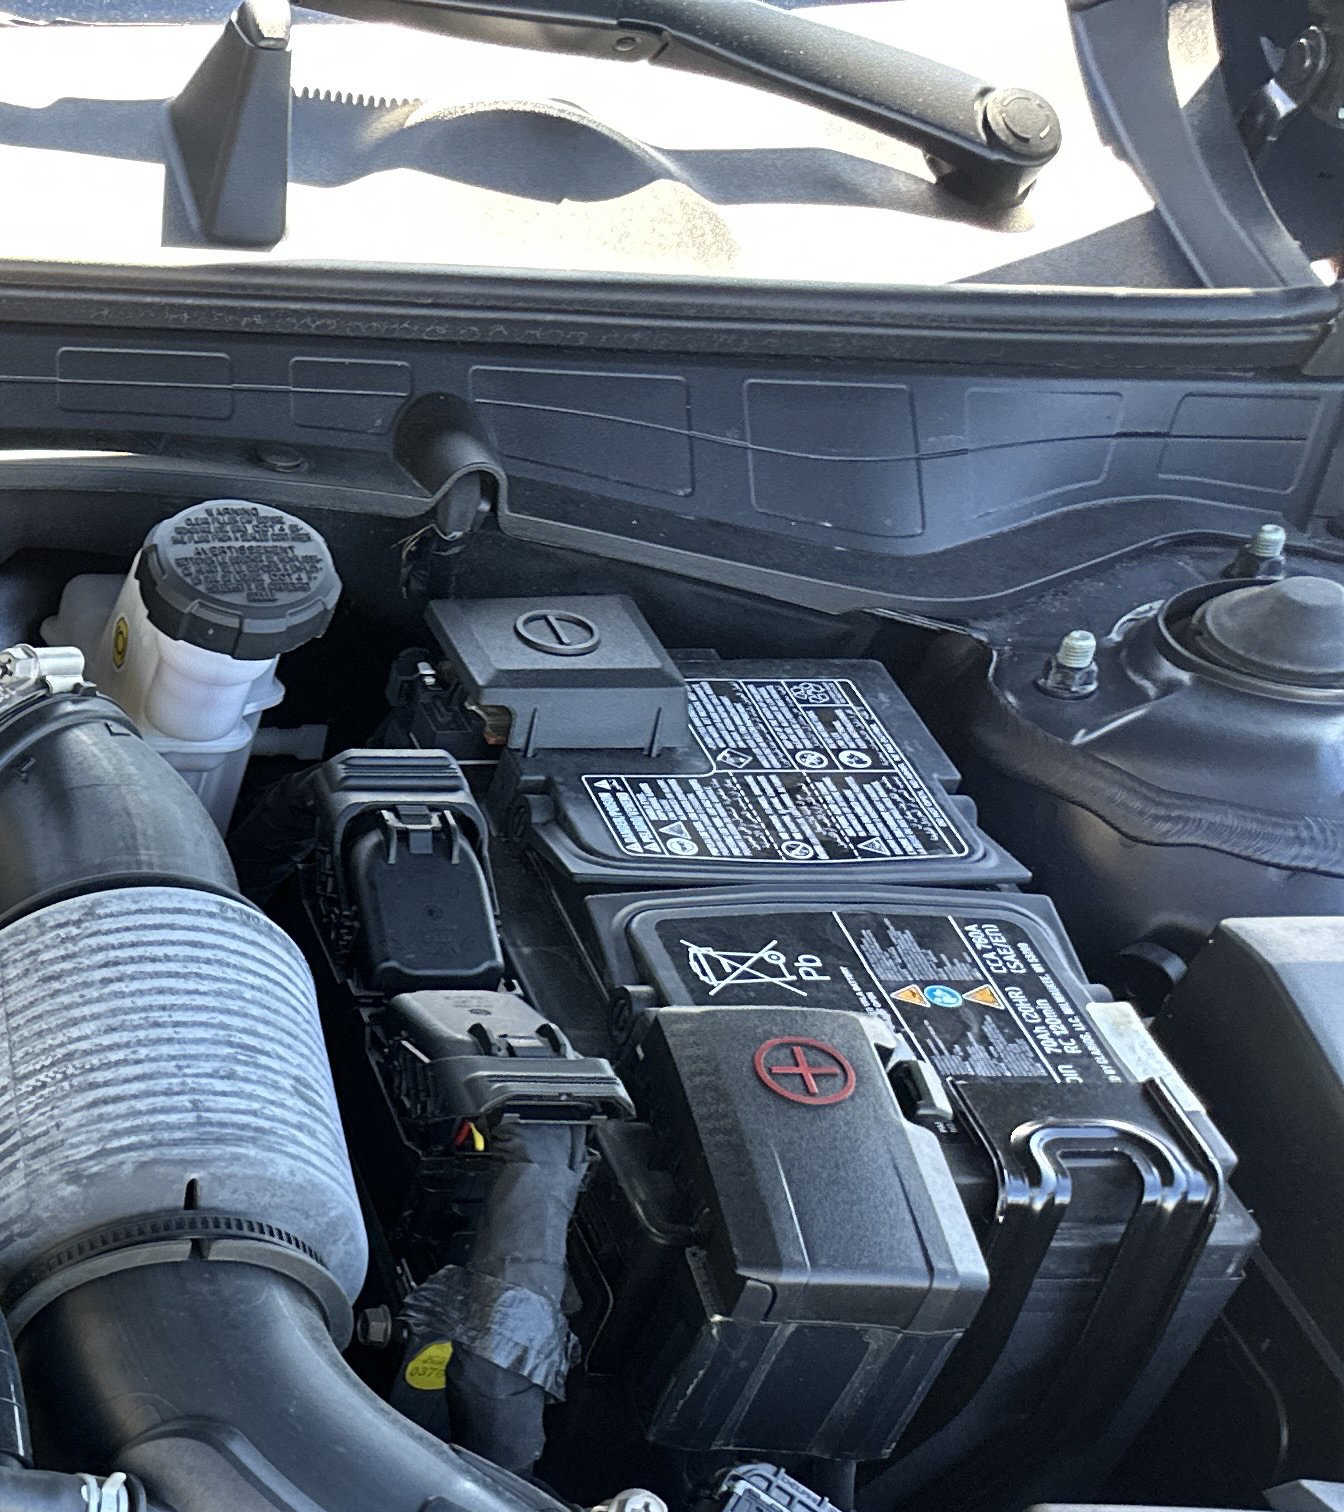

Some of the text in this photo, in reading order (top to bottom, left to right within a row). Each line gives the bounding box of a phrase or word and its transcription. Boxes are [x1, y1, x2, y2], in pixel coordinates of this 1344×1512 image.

[794, 954, 831, 980] Pb
[1002, 985, 1063, 1054] 70Ah (20HR)
[1056, 1038, 1083, 1054] RC
